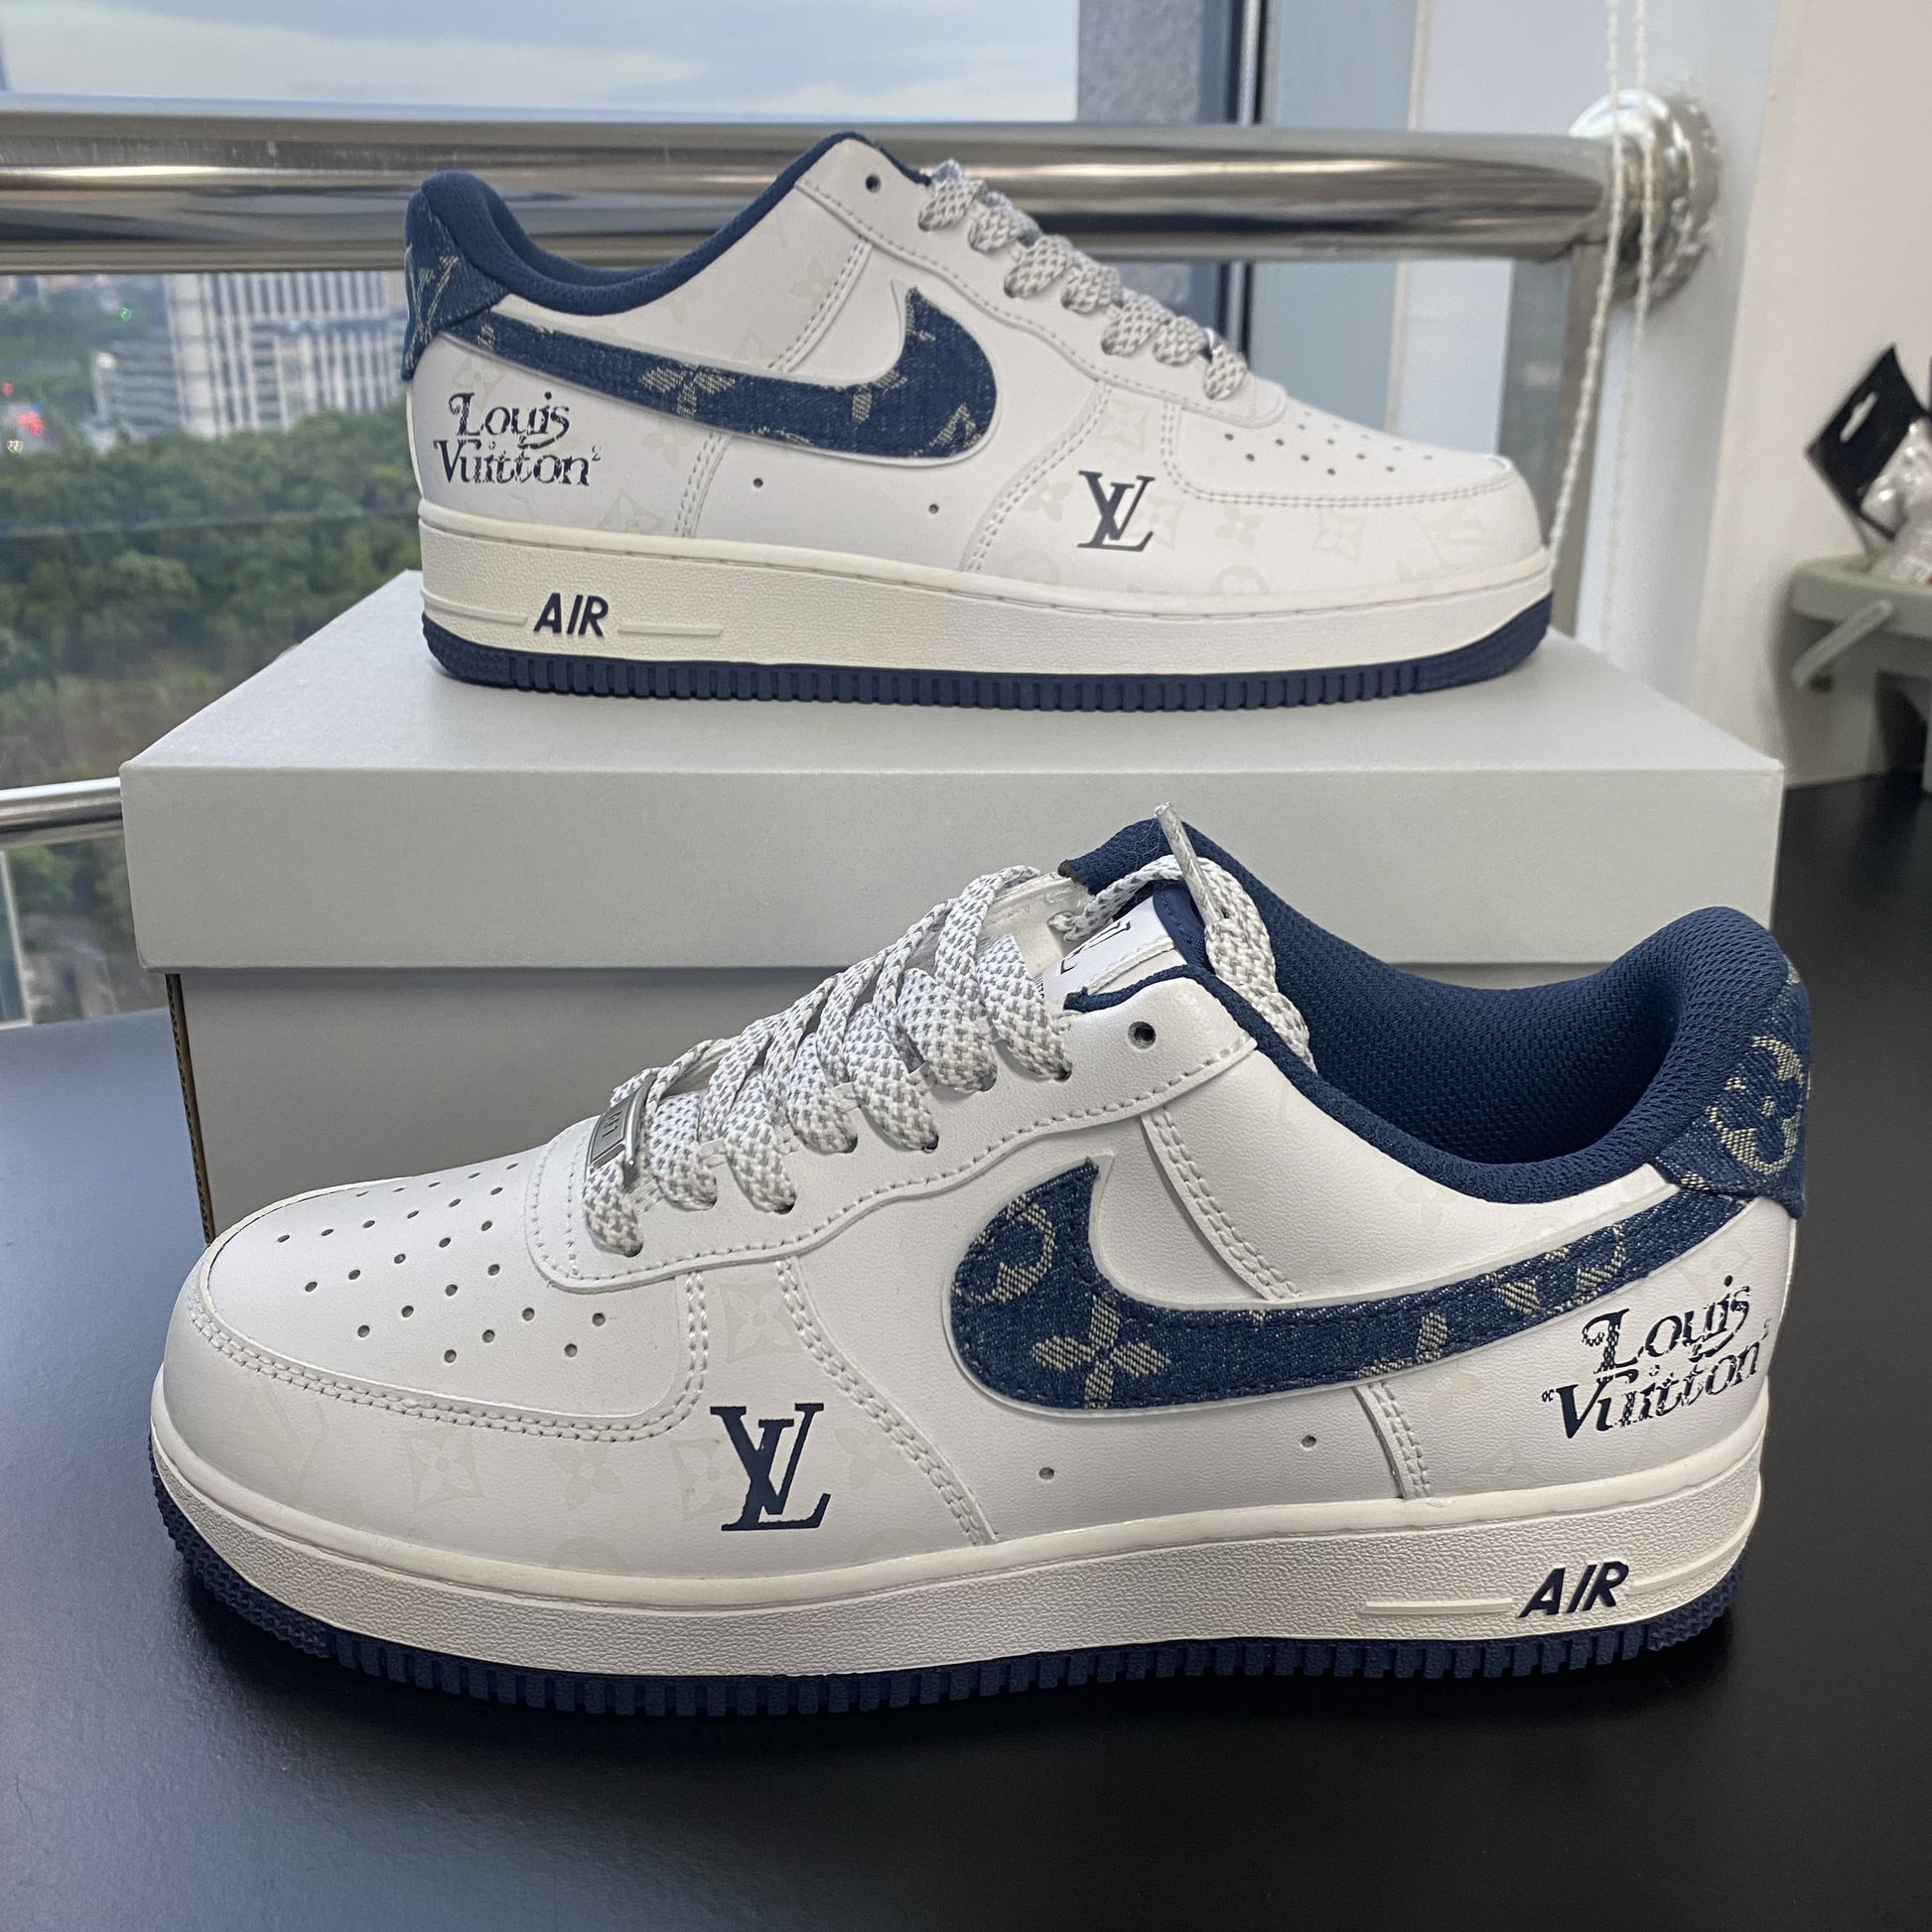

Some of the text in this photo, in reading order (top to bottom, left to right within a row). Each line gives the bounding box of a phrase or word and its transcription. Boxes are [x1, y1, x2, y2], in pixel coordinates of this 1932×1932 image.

[448, 391, 570, 450] Louis
[433, 439, 591, 486] Vuitton
[533, 592, 610, 637] AIR
[1582, 1275, 1751, 1374] Louis
[1555, 1340, 1761, 1440] Vuitton
[1518, 1560, 1629, 1618] AIR
